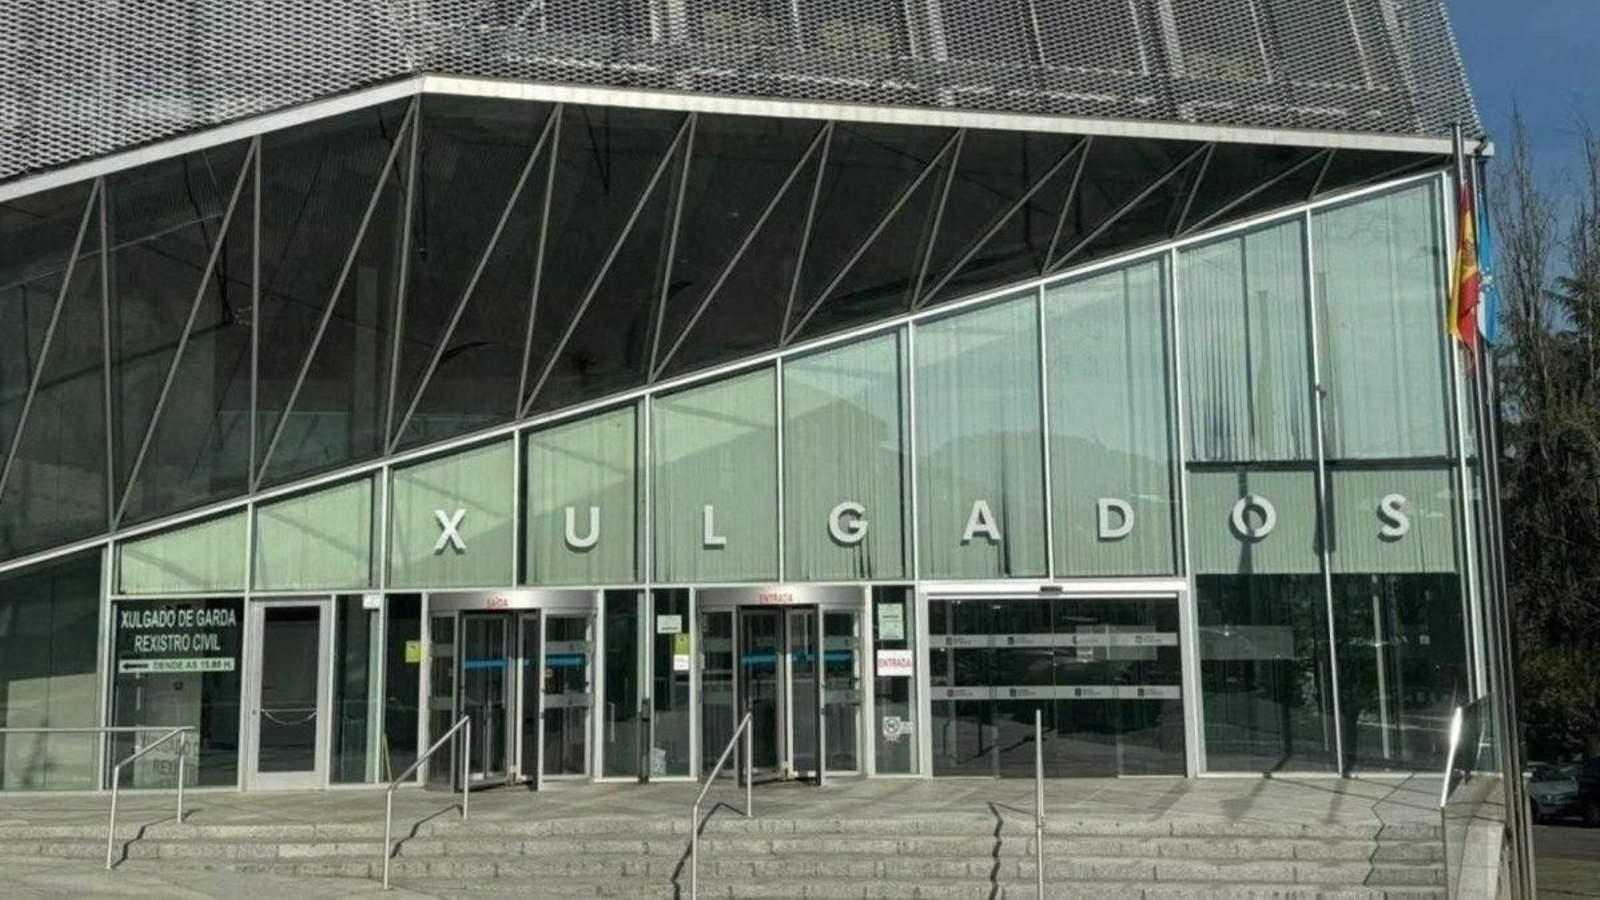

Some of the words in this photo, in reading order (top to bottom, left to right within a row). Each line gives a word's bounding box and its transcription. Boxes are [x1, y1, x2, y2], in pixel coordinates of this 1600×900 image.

[121, 609, 176, 628] XULGADO
[178, 609, 194, 627] DE
[196, 608, 236, 627] GARDA
[134, 634, 191, 652] REXISTRO
[192, 633, 221, 651] CIVIL
[877, 657, 912, 670] ENTRADA
